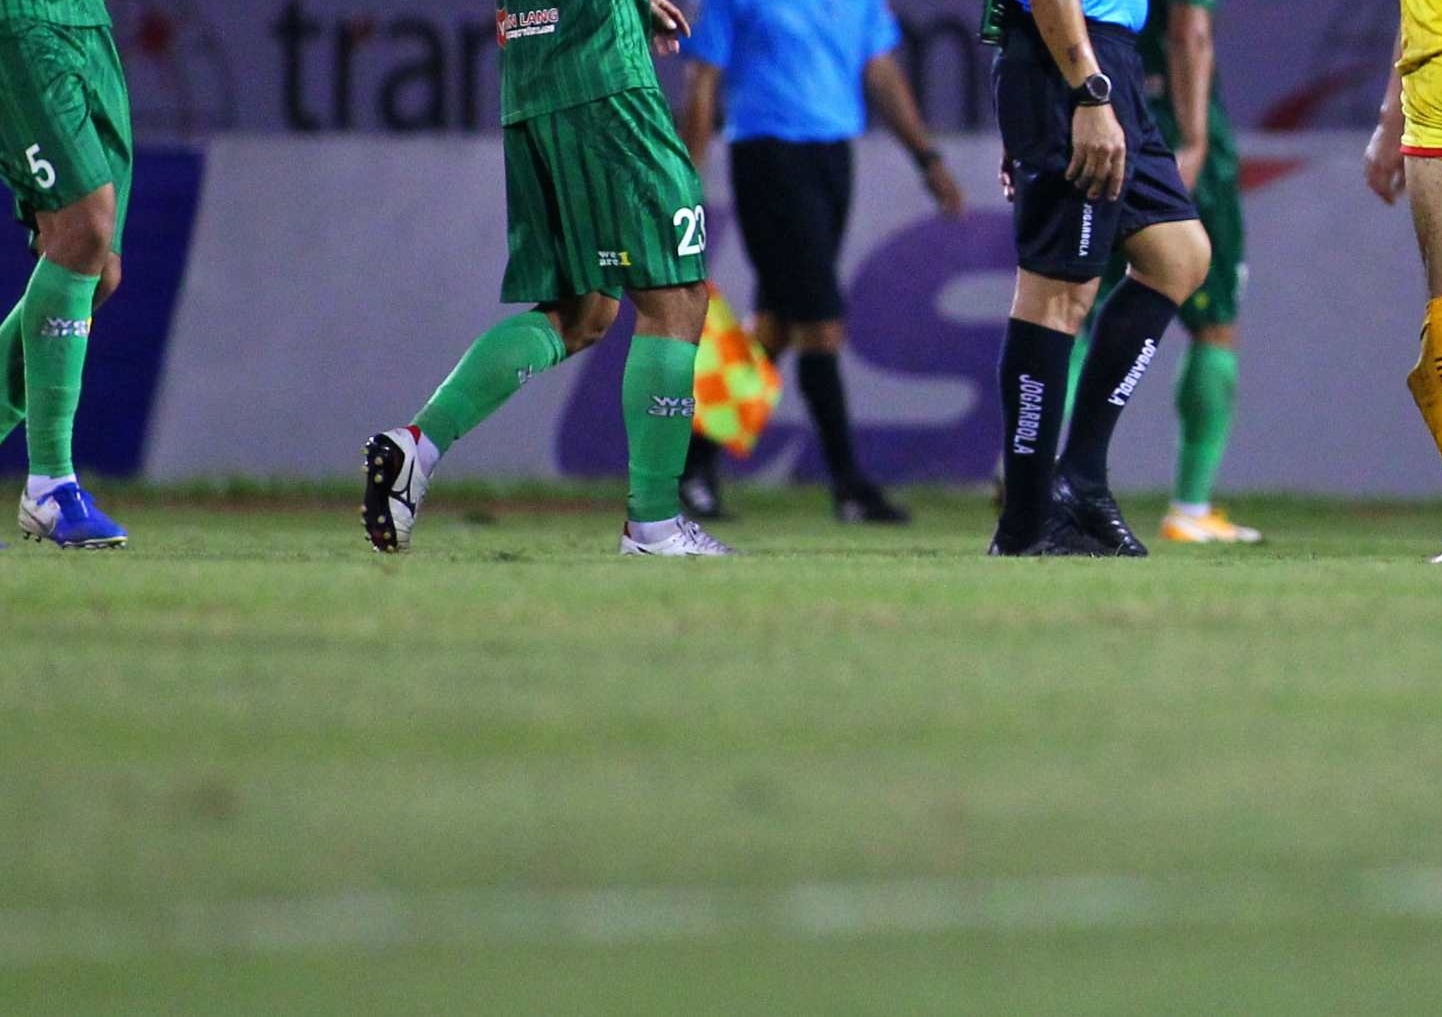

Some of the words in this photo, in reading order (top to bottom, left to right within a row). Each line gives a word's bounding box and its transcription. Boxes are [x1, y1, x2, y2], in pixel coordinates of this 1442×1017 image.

[519, 8, 559, 26] LANG
[25, 143, 56, 189] 5
[673, 205, 706, 257] 23
[1106, 338, 1157, 407] JOGARBOLA
[648, 406, 696, 417] are
[653, 395, 696, 407] we
[1013, 373, 1045, 454] JOGARBOLA
